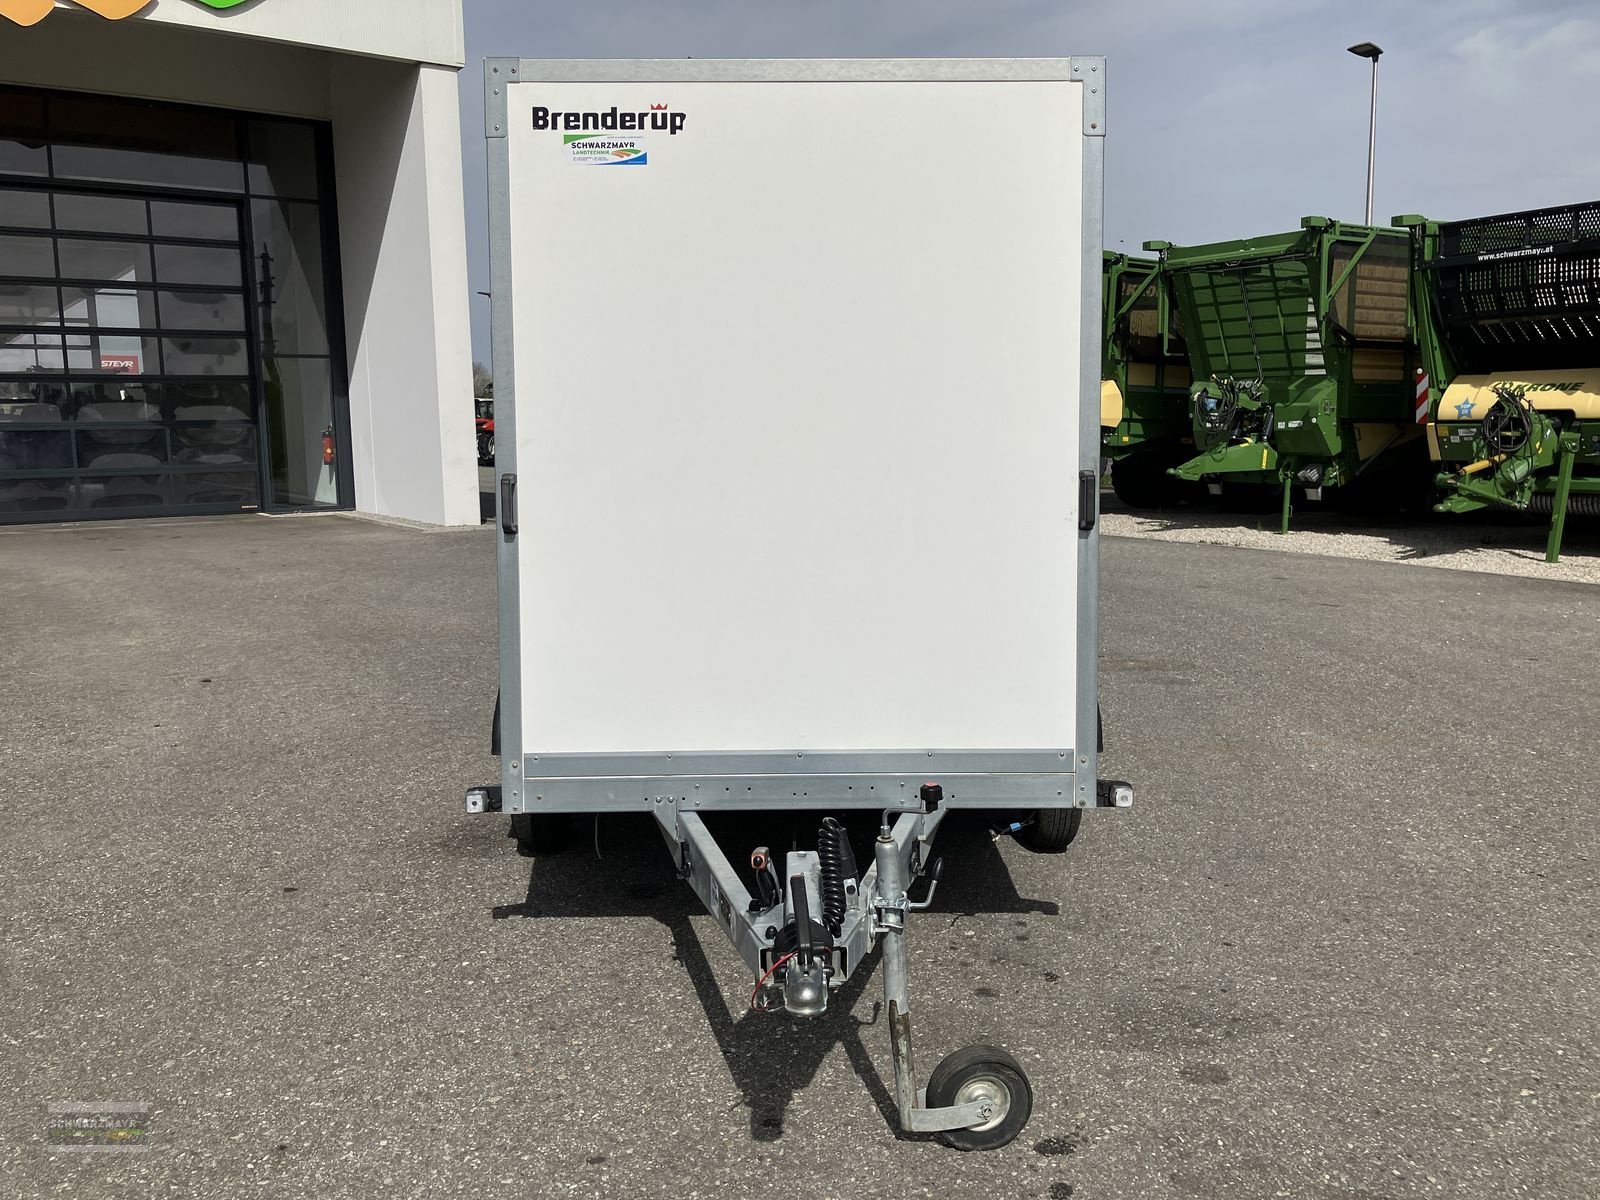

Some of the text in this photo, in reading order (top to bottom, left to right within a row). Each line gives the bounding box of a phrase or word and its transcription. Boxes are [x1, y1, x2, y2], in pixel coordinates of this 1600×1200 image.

[532, 106, 687, 135] Brenderup
[571, 141, 635, 149] SCHWARZMAYR
[1478, 245, 1554, 261] www.schwarzmayr.at
[101, 360, 134, 368] STEYR
[1512, 382, 1585, 394] KRONE
